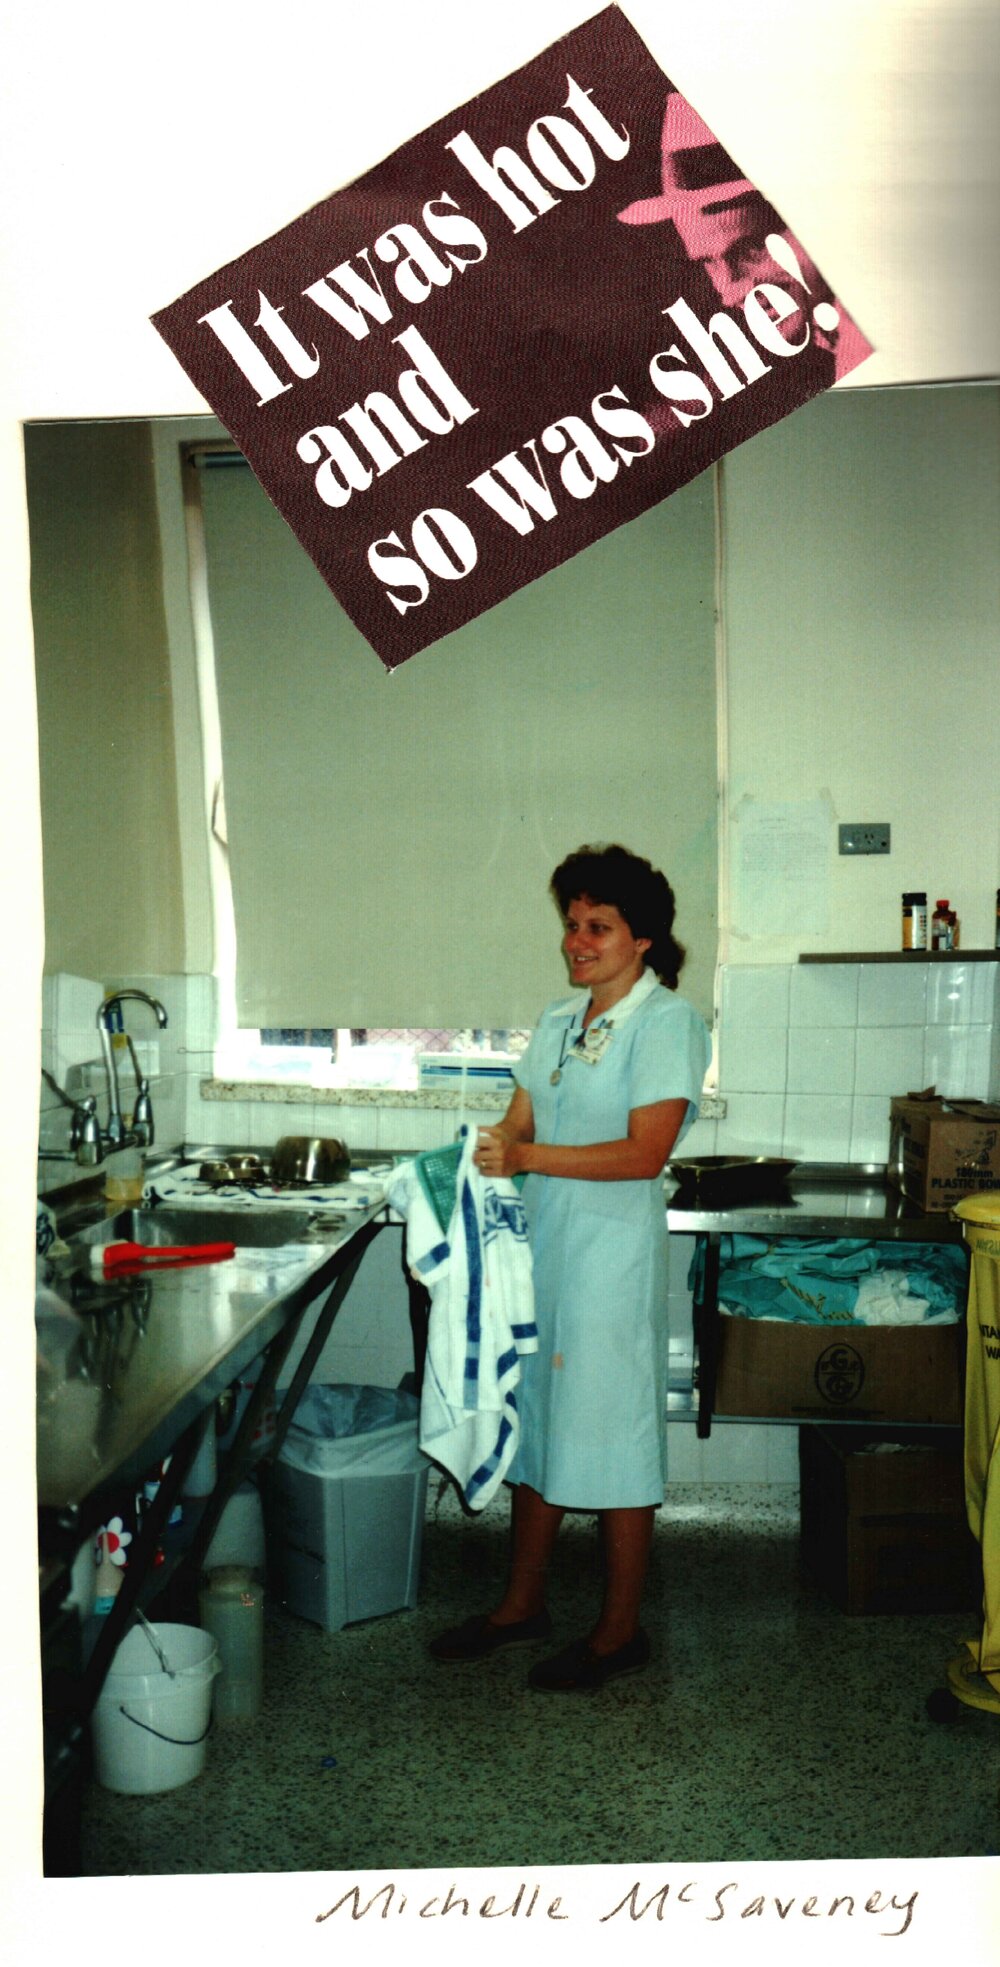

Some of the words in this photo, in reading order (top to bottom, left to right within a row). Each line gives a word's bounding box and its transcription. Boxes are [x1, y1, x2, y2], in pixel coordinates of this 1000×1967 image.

[198, 290, 320, 407] It
[301, 192, 488, 341] was
[445, 74, 630, 234] hot
[296, 324, 479, 508] and
[367, 508, 478, 615] so
[466, 385, 655, 536] was
[649, 233, 840, 428] she!
[931, 1178, 976, 1189] PLASTIC
[314, 1882, 569, 1923] Michelle
